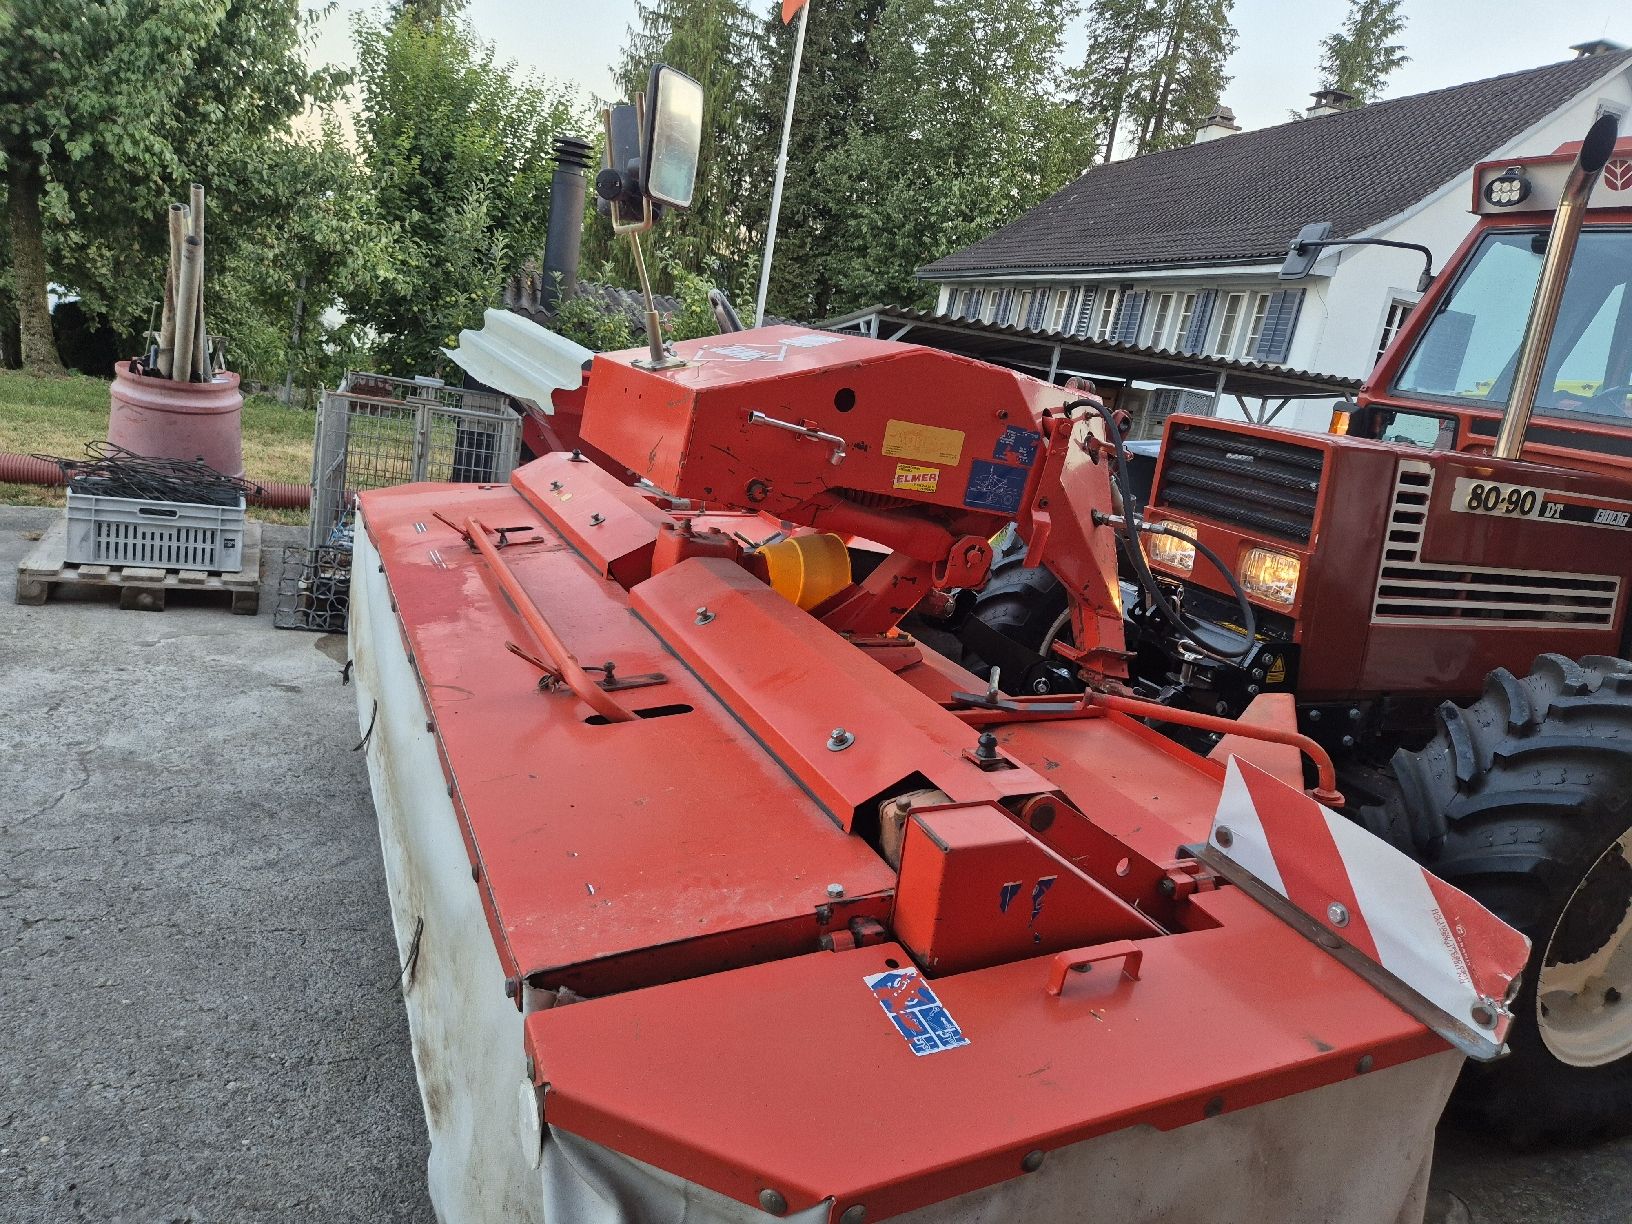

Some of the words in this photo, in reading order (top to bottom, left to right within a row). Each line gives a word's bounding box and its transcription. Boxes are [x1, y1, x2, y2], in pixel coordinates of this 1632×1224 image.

[896, 473, 938, 484] ELMER
[1467, 483, 1537, 516] 80-90
[1545, 502, 1564, 519] DT
[1593, 508, 1631, 527] FIAT
